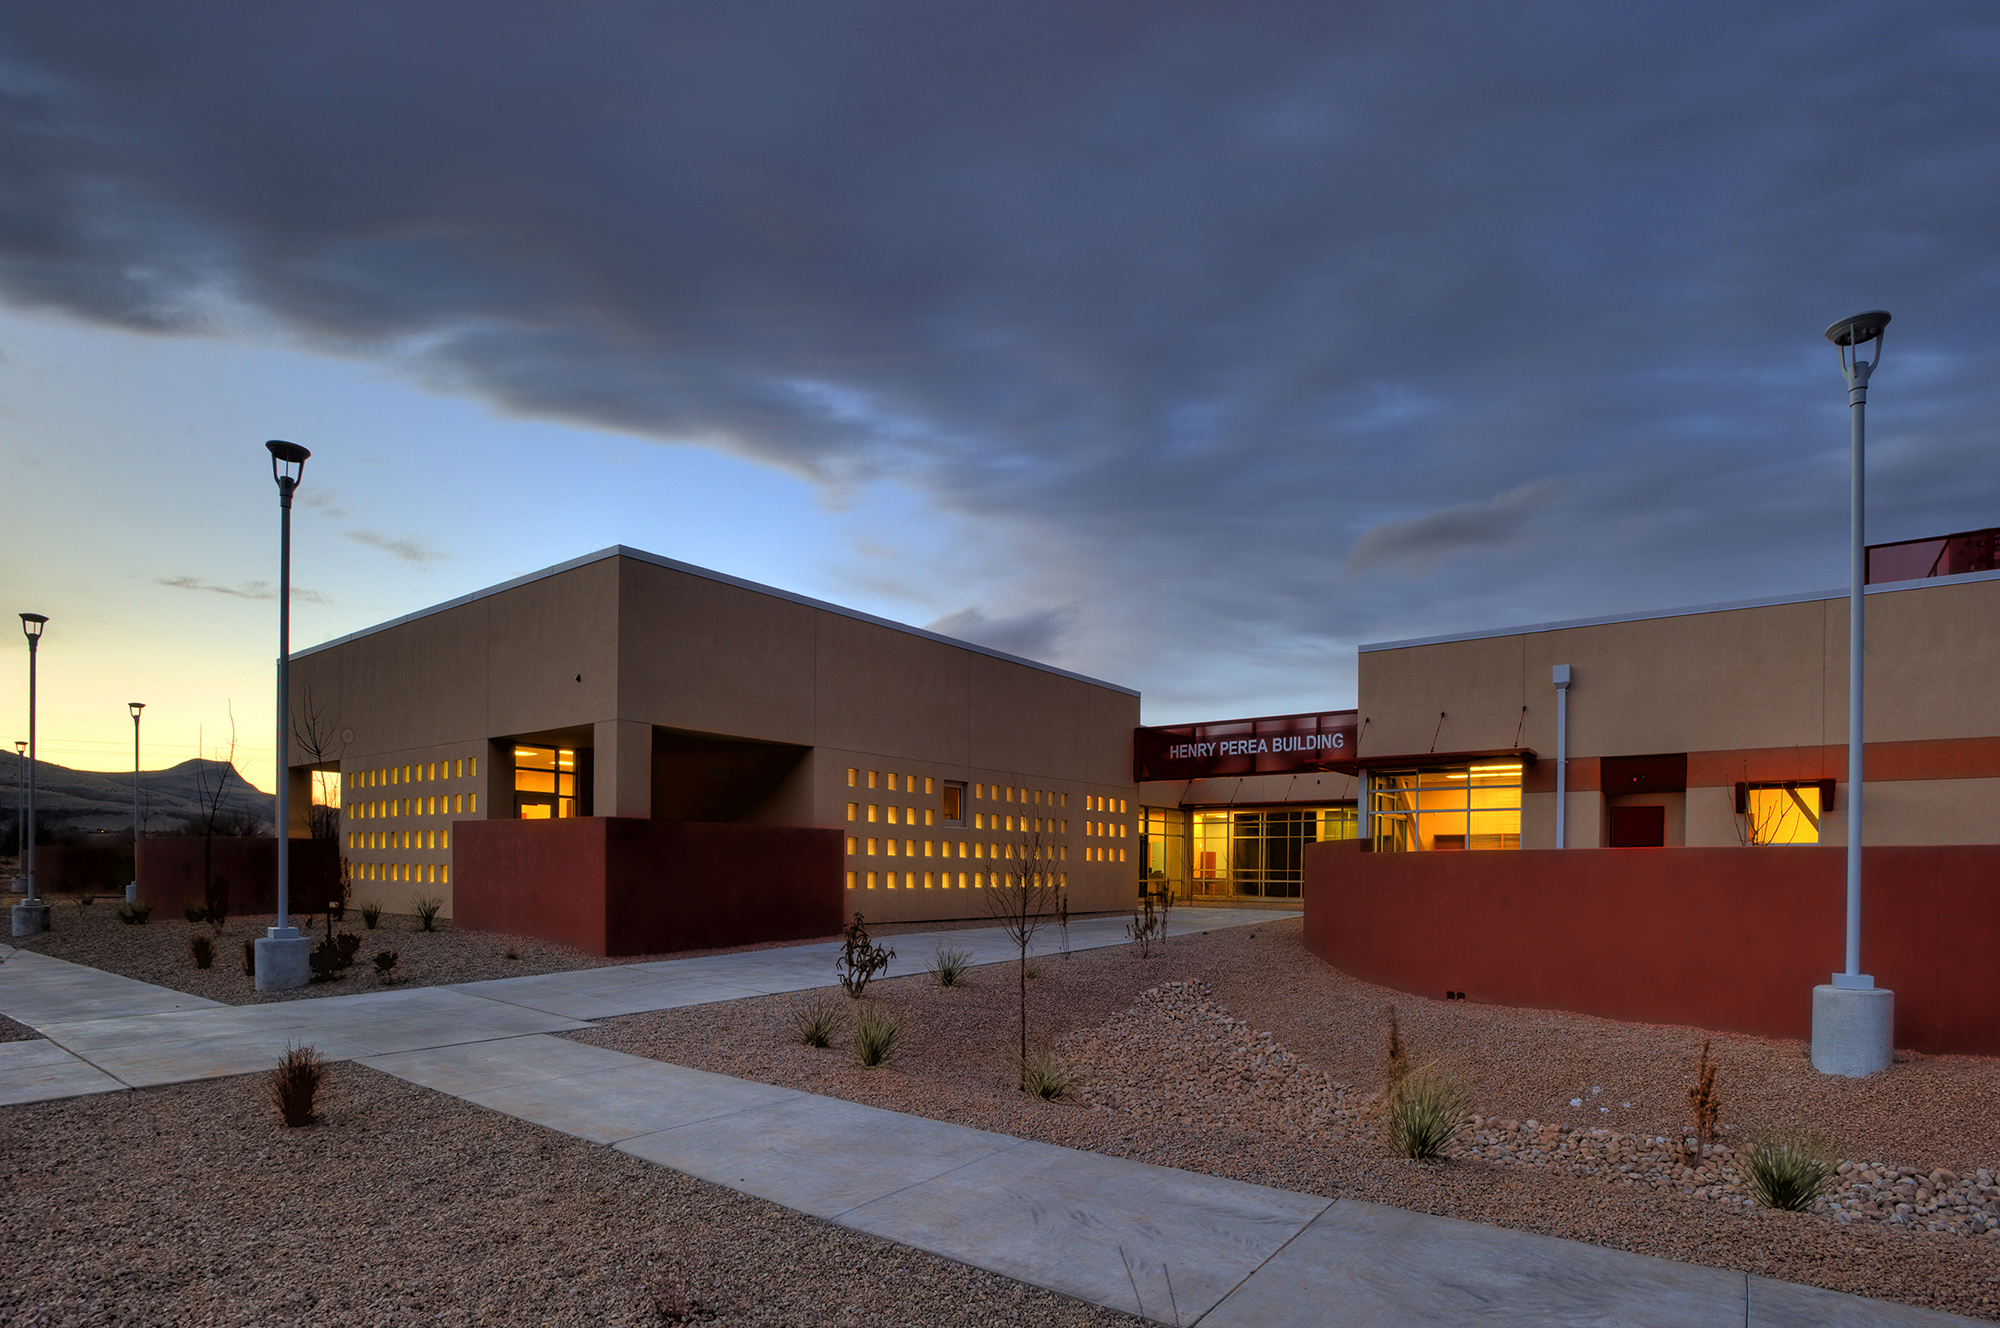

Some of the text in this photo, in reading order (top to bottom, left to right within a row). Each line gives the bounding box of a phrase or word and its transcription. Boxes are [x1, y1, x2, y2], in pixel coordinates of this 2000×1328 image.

[1170, 733, 1344, 758] HENRY PEREA BUILDING
